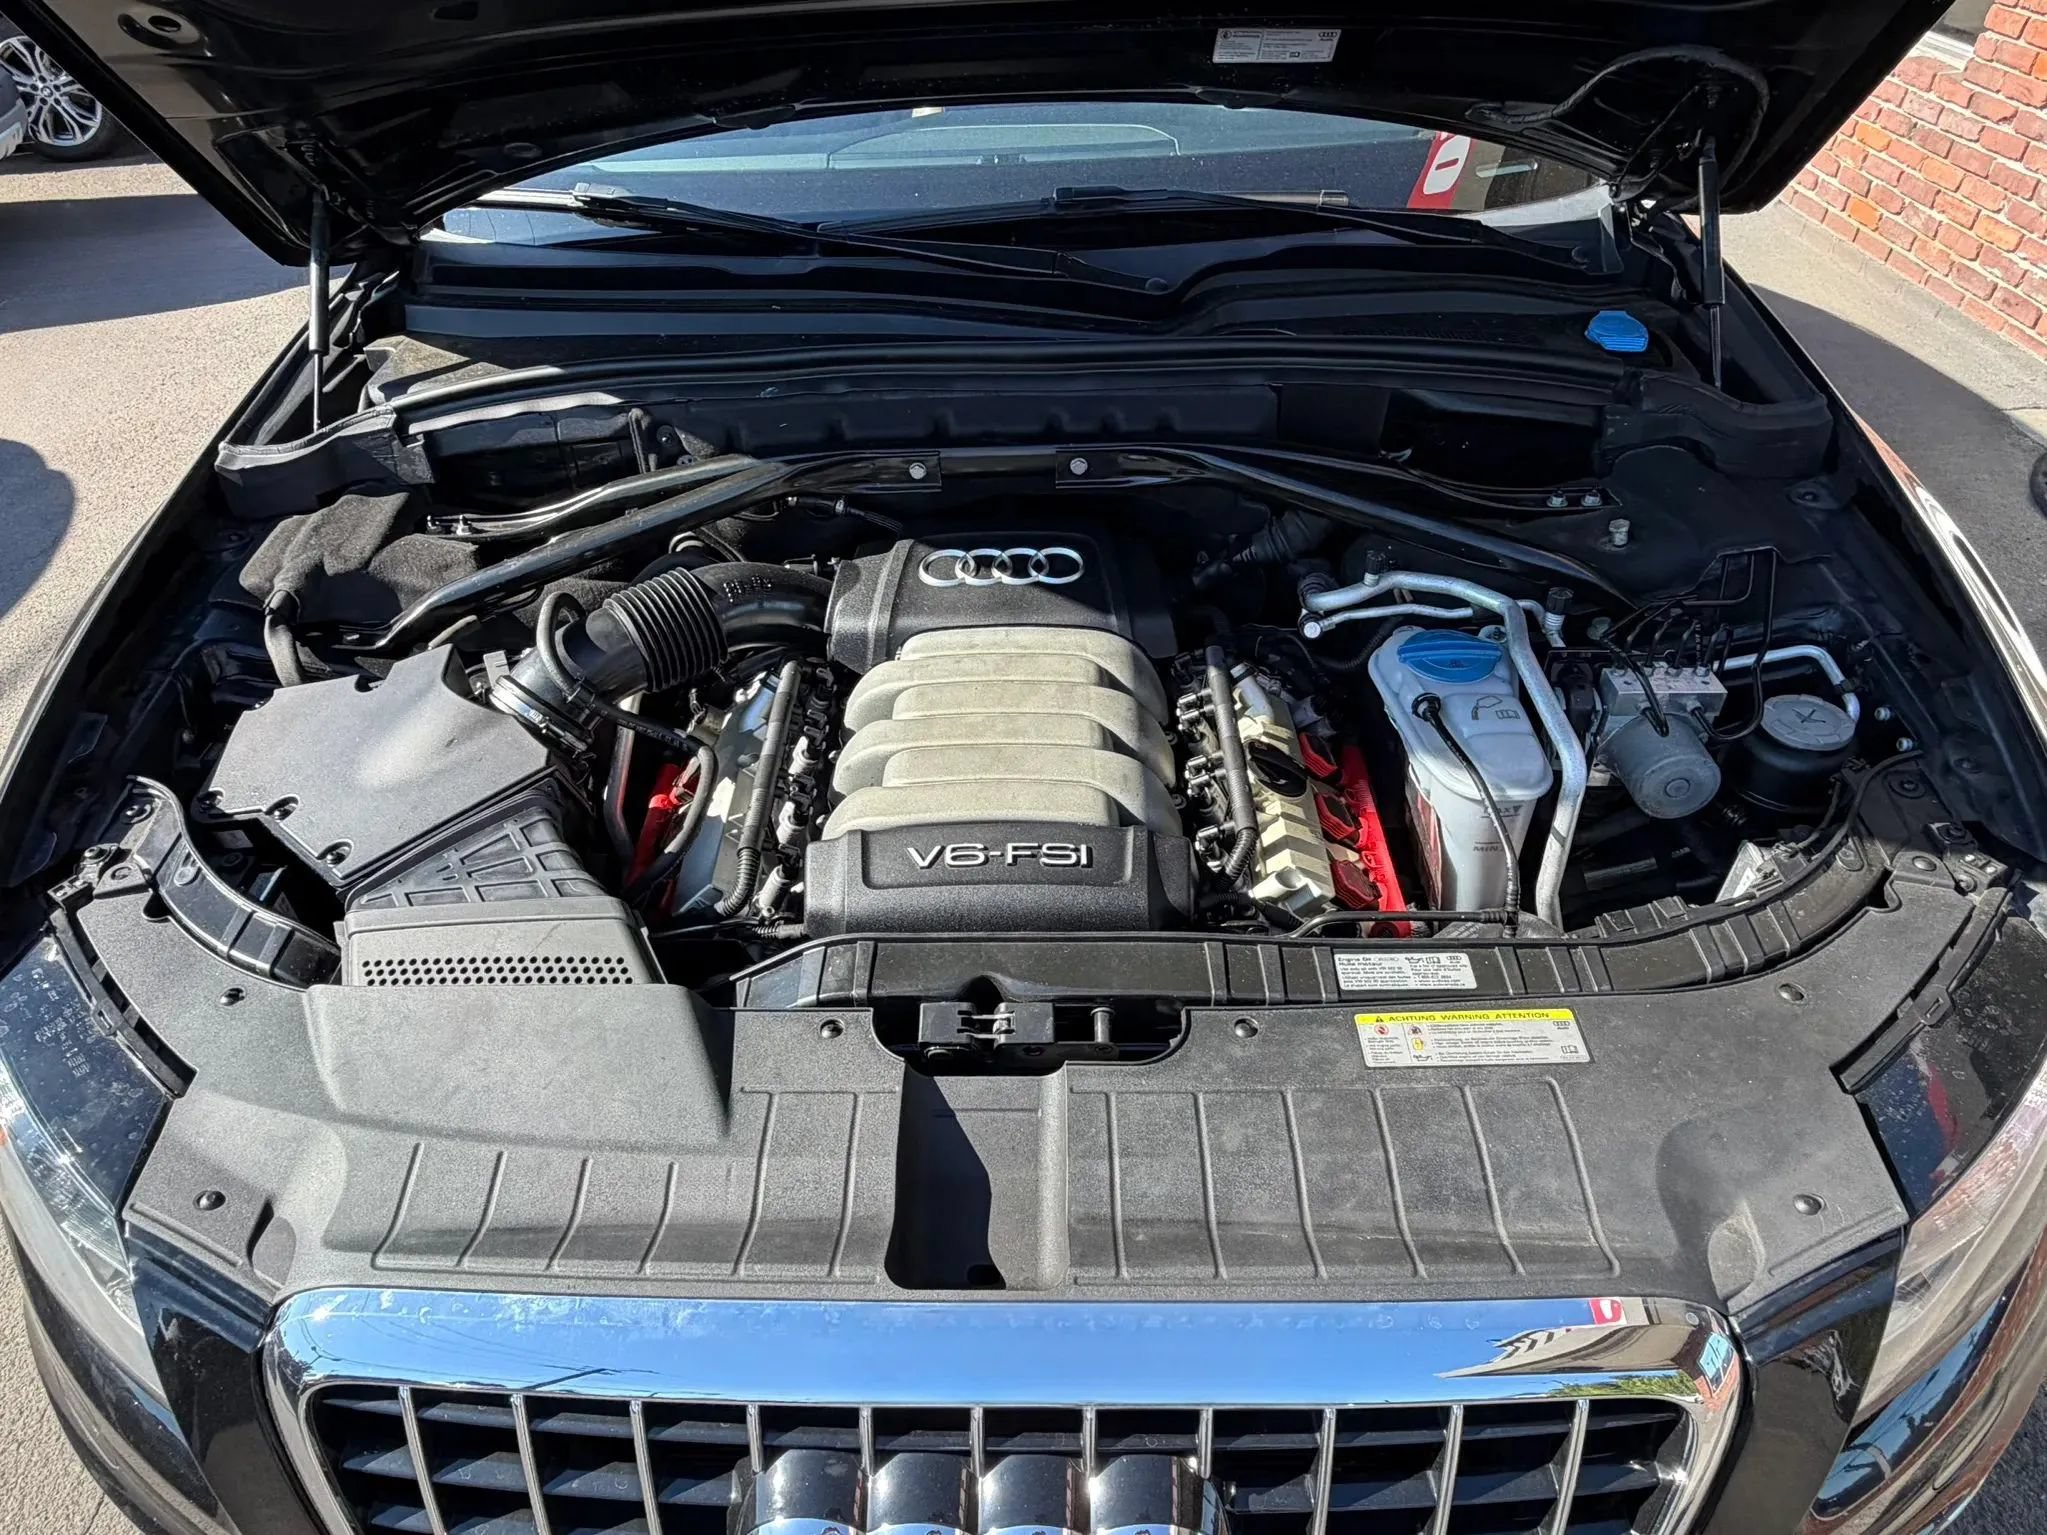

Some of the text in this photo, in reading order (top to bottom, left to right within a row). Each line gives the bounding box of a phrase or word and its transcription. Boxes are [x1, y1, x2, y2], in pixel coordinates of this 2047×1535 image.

[907, 843, 1090, 868] V6-FSI
[1388, 1011, 1550, 1022] ACHTUNG WARNING ATTENTION
